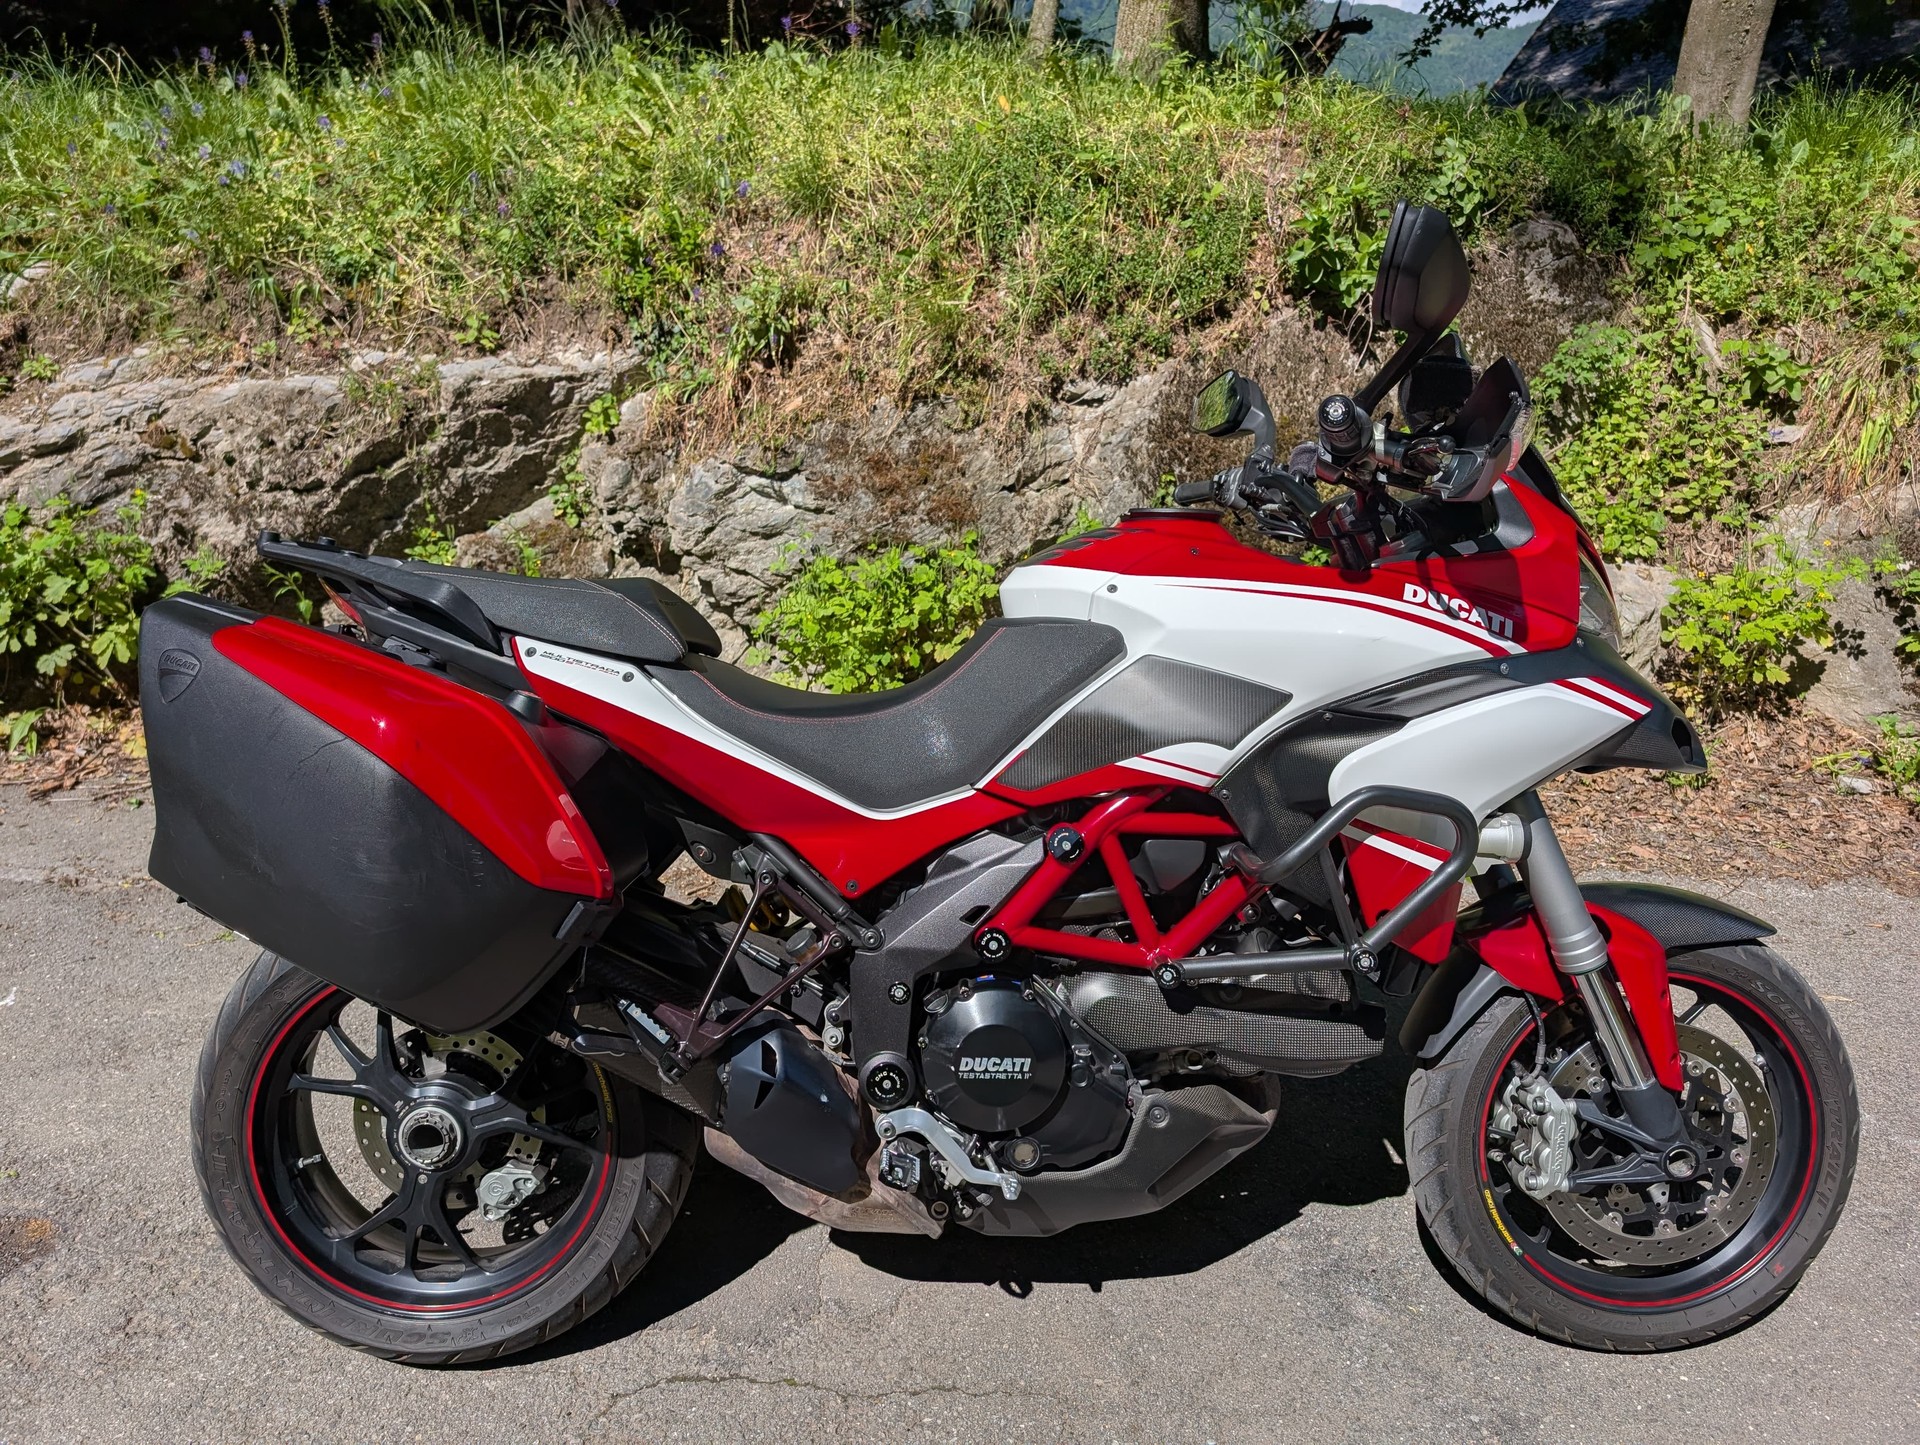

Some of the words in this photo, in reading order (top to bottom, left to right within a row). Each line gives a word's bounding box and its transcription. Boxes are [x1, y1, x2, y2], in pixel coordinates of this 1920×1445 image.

[1402, 582, 1513, 639] DUCATI
[163, 654, 198, 671] DUCATI
[542, 650, 620, 675] MULTISTRADA
[1752, 981, 1838, 1100] SCORPION
[958, 1056, 1032, 1072] DUCATI
[875, 1071, 888, 1082] CNC
[957, 1072, 1022, 1080] TESTASTRETTA
[1489, 1208, 1514, 1243] marchesini
